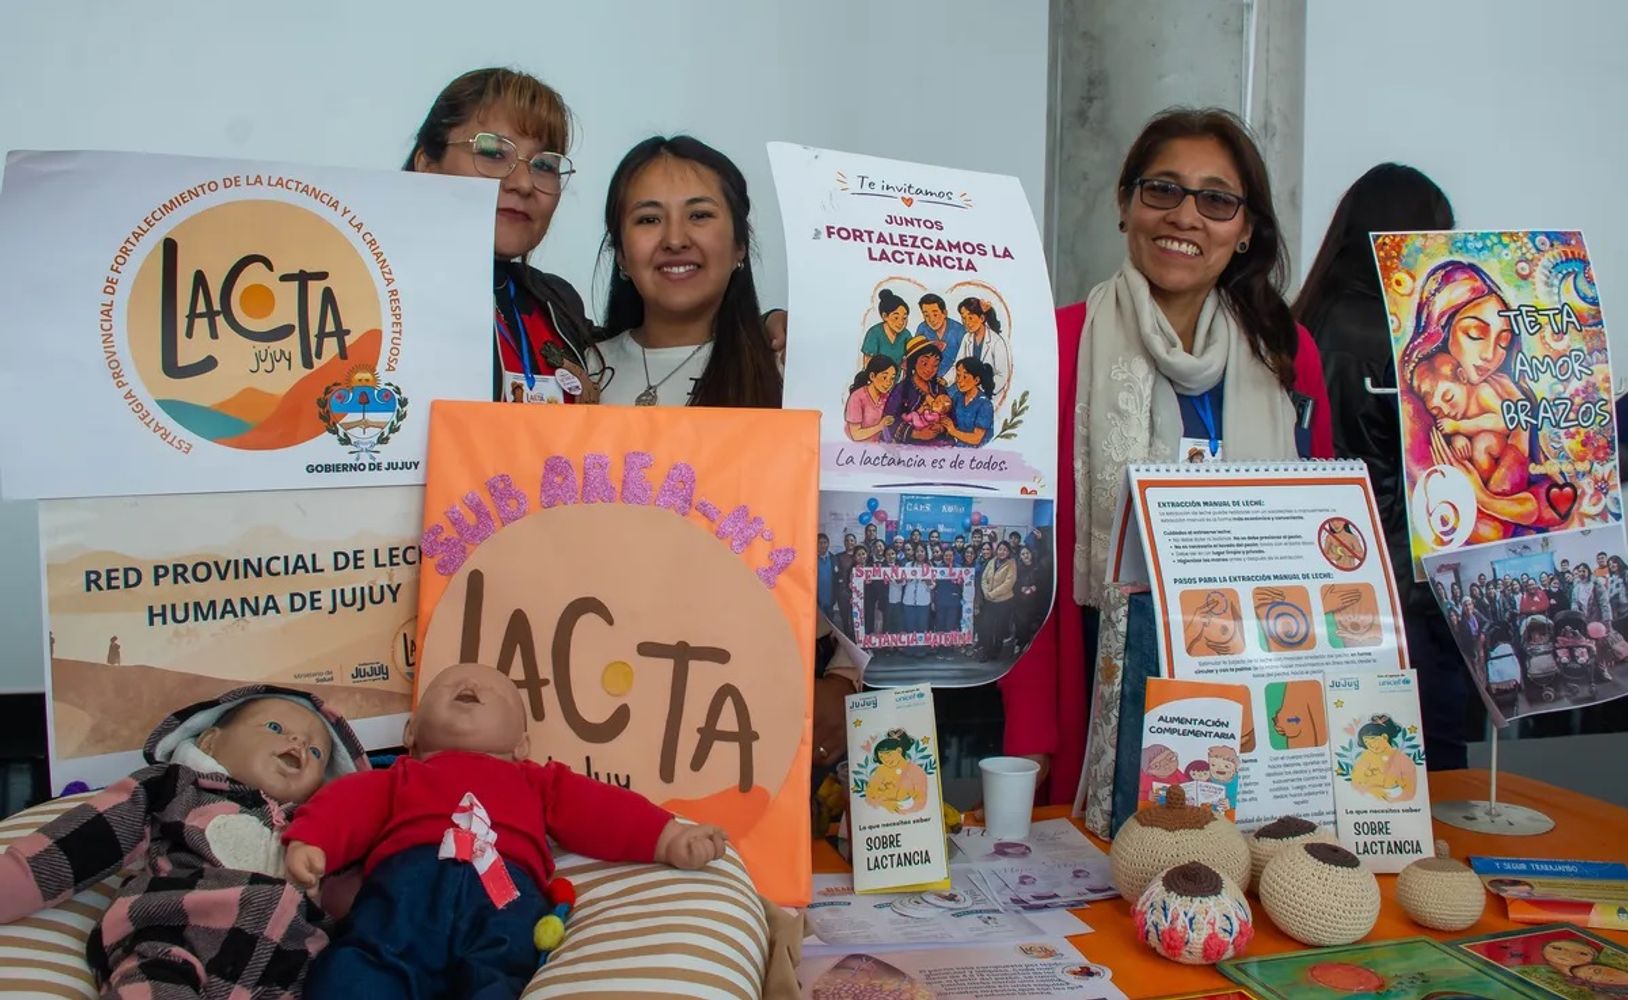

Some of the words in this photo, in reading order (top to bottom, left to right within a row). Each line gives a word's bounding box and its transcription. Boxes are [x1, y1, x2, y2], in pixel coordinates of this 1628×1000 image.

[223, 175, 242, 189] DE
[246, 174, 263, 186] LA
[857, 175, 876, 190] Te
[881, 180, 954, 200] invitamos
[268, 176, 340, 211] LACTANCIA
[340, 206, 352, 218] Y
[348, 215, 364, 234] LA
[884, 214, 944, 230] JUNTOS
[110, 180, 219, 275] FORTALECIMIENTO
[826, 224, 988, 256] FORTALEZCAMOS
[992, 244, 1015, 260] LA
[362, 232, 394, 286] CRIANZA
[868, 247, 978, 272] LACTANCIA
[103, 276, 119, 297] DE
[162, 237, 352, 379] LACTA
[1498, 302, 1583, 336] TETA
[385, 289, 402, 373] RESPETUOSA
[100, 300, 127, 389] PROVINCIAL
[249, 346, 292, 373] jujuy
[1514, 350, 1594, 382] AMOR
[121, 389, 193, 455] ESTRATEGIA
[1500, 398, 1612, 432] BRAZOS
[306, 462, 366, 473] GOBIERNO
[368, 462, 382, 471] DE
[384, 461, 420, 470] JUJUY
[836, 448, 854, 466] La
[860, 450, 927, 468] lactancia
[931, 458, 944, 469] es
[950, 454, 964, 470] de
[969, 455, 1008, 472] todos.
[421, 474, 529, 576] SUB
[84, 567, 142, 592] RED
[154, 552, 324, 586] PROVINCIAL
[333, 550, 364, 570] DE
[1228, 574, 1272, 583] EXTRACCIÓN
[148, 594, 280, 626] HUMANA
[289, 590, 322, 612] DE
[328, 582, 402, 614] JUJUY
[1149, 726, 1236, 740] COMPLEMENTARIA
[1158, 715, 1230, 728] ALIMENTACIÓN
[1354, 821, 1391, 836] SOBRE
[866, 833, 902, 851] SOBRE
[1355, 840, 1423, 855] LACTANCIA
[867, 850, 932, 871] LACTANCIA
